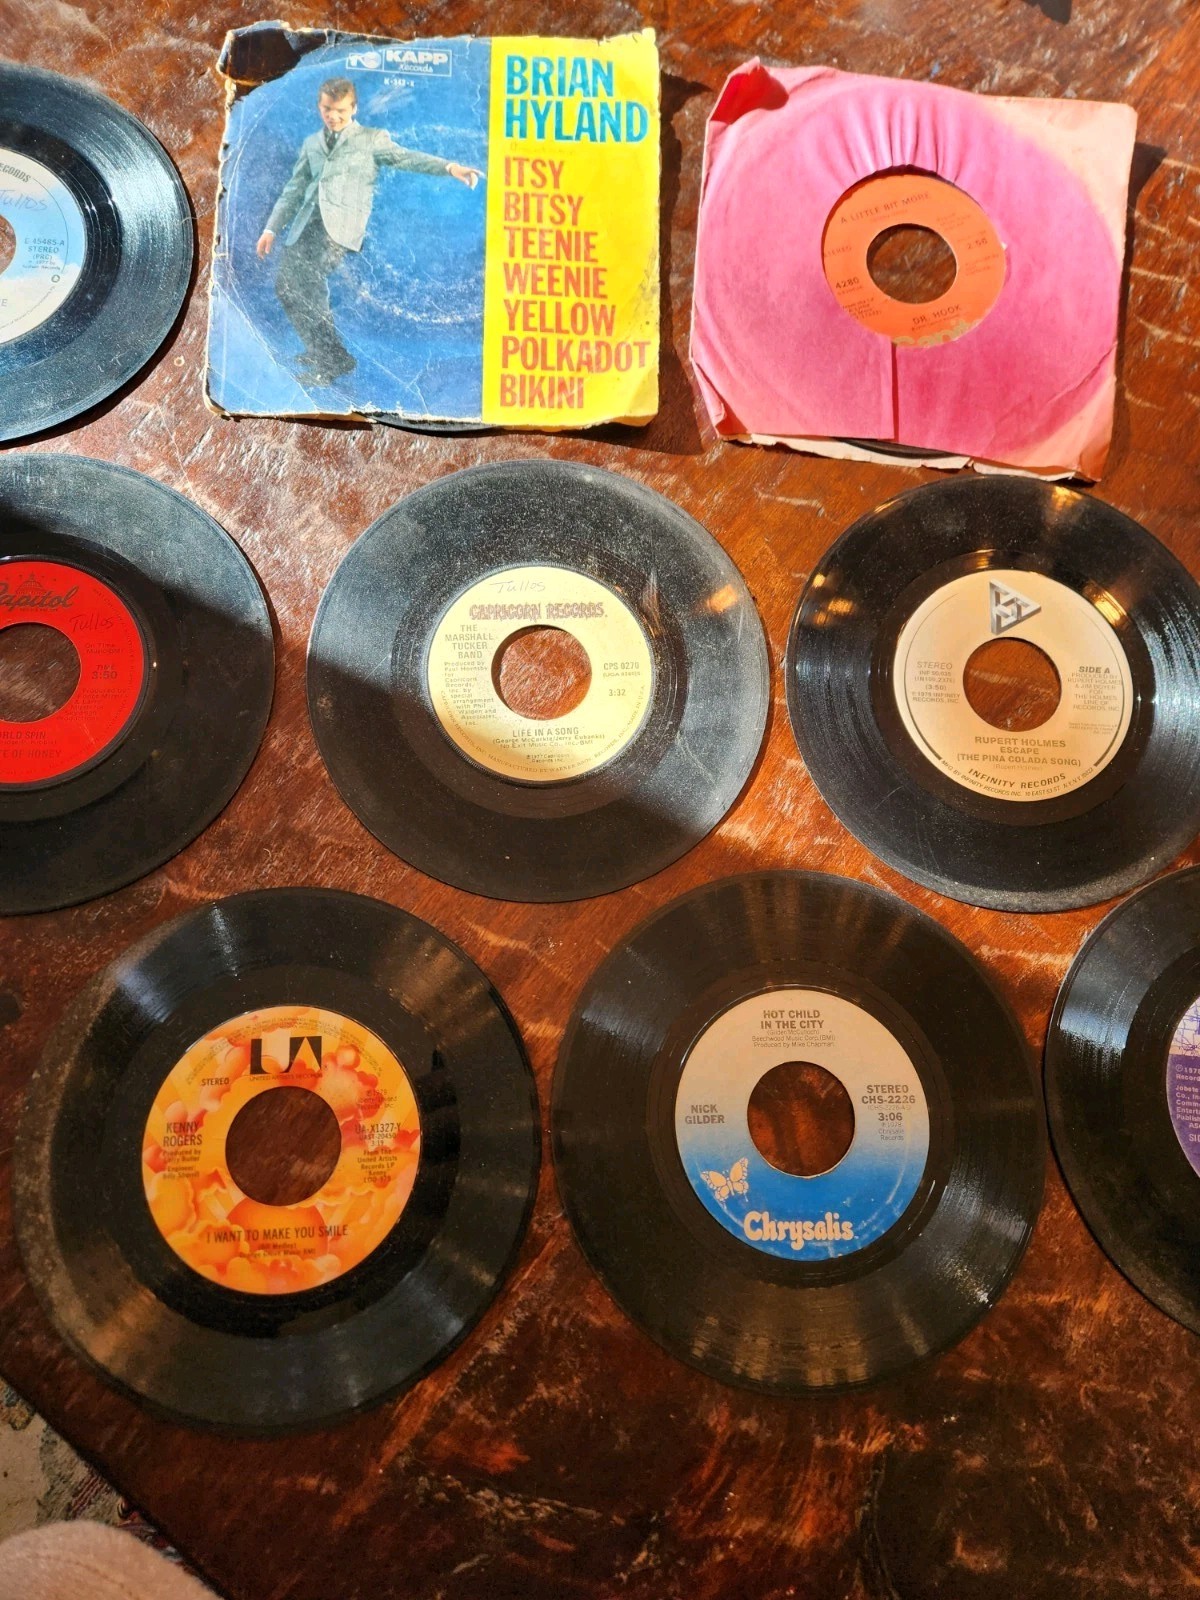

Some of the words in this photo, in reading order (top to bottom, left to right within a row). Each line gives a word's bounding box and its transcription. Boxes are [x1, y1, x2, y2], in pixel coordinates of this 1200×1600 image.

[386, 50, 448, 65] KAPP
[506, 54, 614, 97] BRIAN
[505, 98, 649, 143] HYLAND
[504, 156, 564, 189] ITSY
[504, 191, 584, 226] BITSY
[841, 216, 847, 224] A
[850, 207, 879, 221] LITTLE
[883, 201, 898, 211] BIT
[902, 191, 929, 206] MORE
[28, 245, 60, 254] STEREO
[503, 226, 599, 263] TEENIE
[503, 262, 608, 299] WEENIE
[932, 304, 961, 318] HOOK
[503, 299, 616, 337] YELLOW
[502, 335, 651, 374] POLKADOT
[500, 373, 584, 409] BIKINI
[490, 580, 546, 594] Tullos
[469, 603, 542, 622] CAPRICORN
[460, 624, 478, 632] THE
[445, 632, 494, 641] MARSHALL
[452, 641, 488, 650] TUCKER
[458, 650, 483, 659] BAND
[603, 662, 619, 670] CPS
[620, 661, 640, 670] 0270
[916, 661, 953, 670] STEREO
[1079, 665, 1102, 674] SIDE
[91, 670, 118, 680] 3:50
[608, 688, 627, 697] 3:32
[512, 729, 532, 737] LIFE
[534, 728, 544, 737] IN
[546, 728, 553, 736] A
[555, 727, 579, 735] SONG
[974, 736, 1018, 745] RUPERT
[1021, 738, 1067, 748] HOLMES
[28, 749, 62, 759] HONEY
[999, 746, 1040, 755] ESCAPE
[957, 753, 980, 762] (THE
[982, 754, 1006, 762] PINA
[1007, 755, 1048, 765] COLADA
[1050, 757, 1081, 767] SONG)
[968, 768, 1016, 788] INFINITY
[1020, 772, 1066, 789] RECORDS
[763, 1010, 785, 1019] HOT
[788, 1009, 821, 1019] CHILD
[760, 1020, 772, 1029] IN
[775, 1020, 797, 1029] THE
[799, 1019, 824, 1029] CITY
[250, 1035, 323, 1075] UA
[201, 1077, 230, 1087] STEREO
[866, 1084, 909, 1094] STEREO
[861, 1095, 916, 1104] CHS-2226
[690, 1104, 719, 1114] NICK
[684, 1114, 725, 1125] GILDER
[877, 1112, 903, 1121] 3:06
[166, 1121, 200, 1133] KENNY
[163, 1134, 203, 1147] ROGERS
[213, 1230, 242, 1243] WANT
[246, 1230, 259, 1241] TO
[263, 1228, 291, 1240] MAKE
[294, 1226, 315, 1238] YOU
[318, 1225, 348, 1237] SMILE
[743, 1210, 855, 1250] Chrysalis
